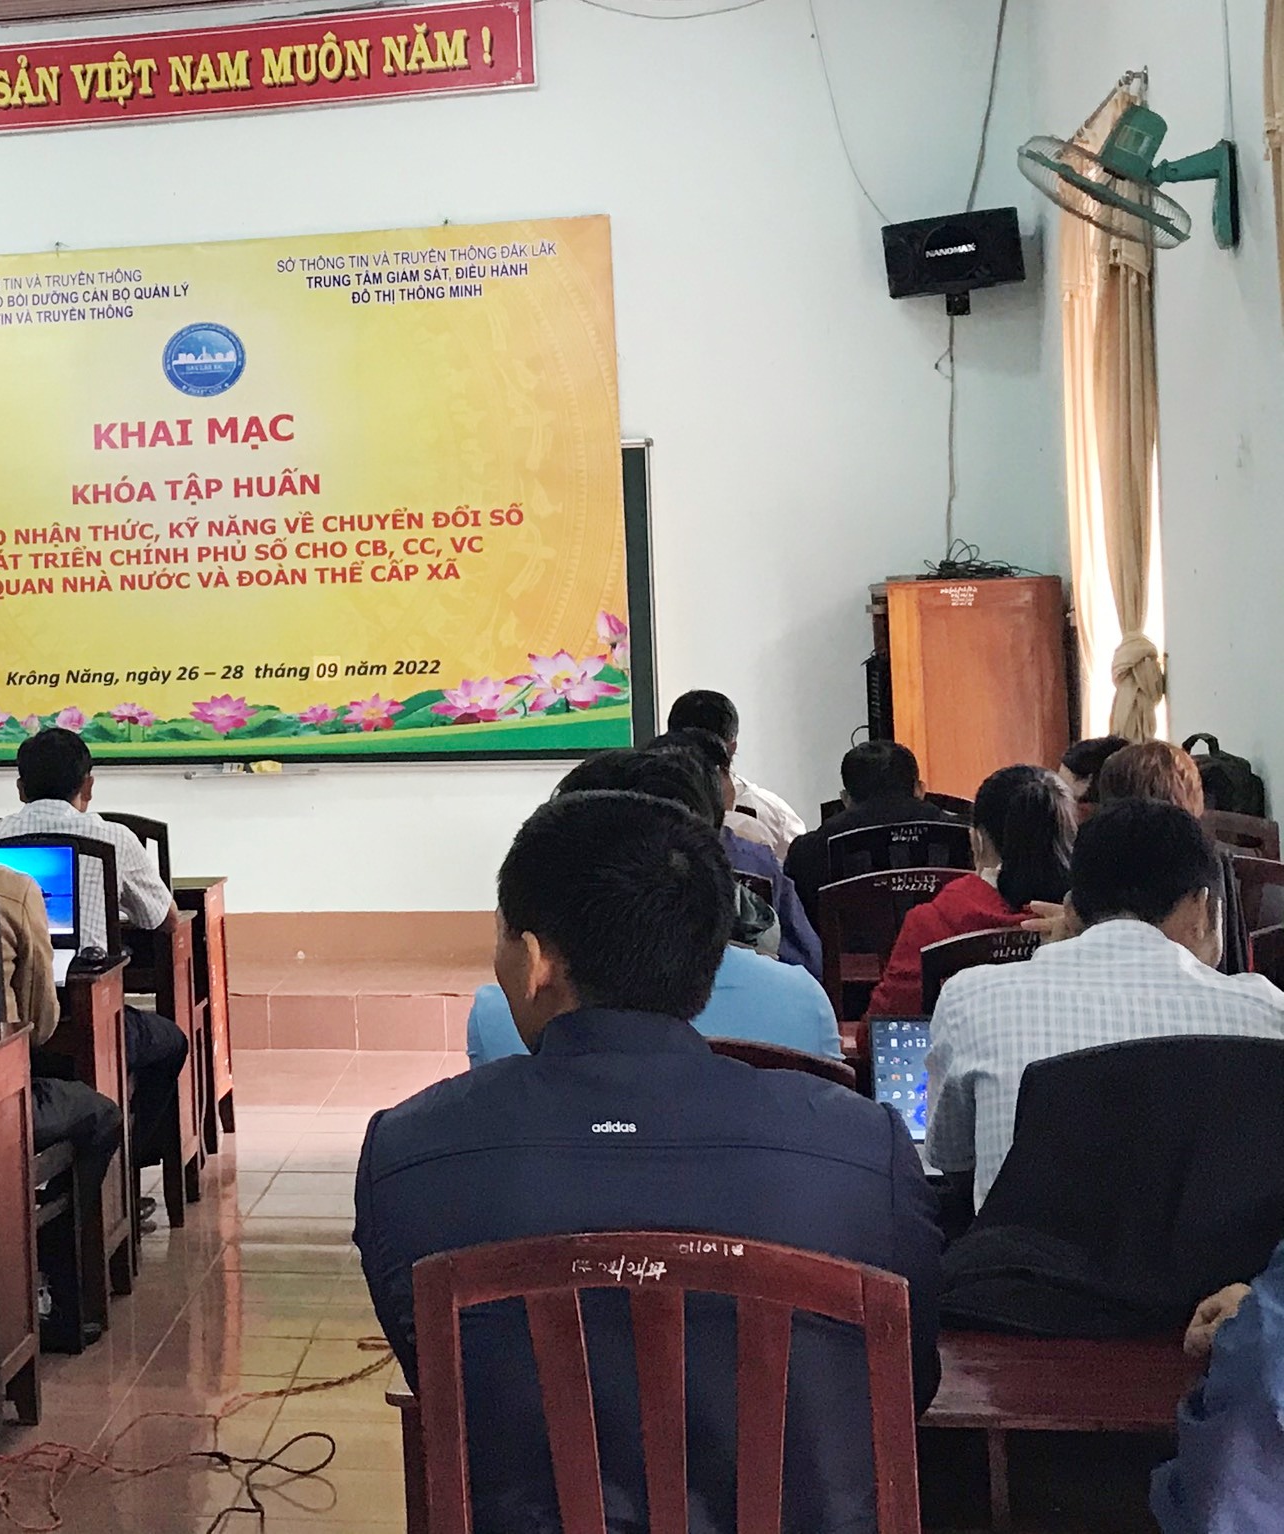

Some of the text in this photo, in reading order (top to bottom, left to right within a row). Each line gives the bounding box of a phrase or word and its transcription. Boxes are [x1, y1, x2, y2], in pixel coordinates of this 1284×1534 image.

[70, 51, 157, 106] VIỆT
[168, 50, 250, 94] NAM
[261, 31, 370, 86] MUÔN
[381, 22, 468, 74] NĂM
[481, 26, 493, 65] !
[299, 255, 345, 271] THÔNG
[348, 255, 369, 268] TIN
[372, 250, 390, 266] VÀ
[450, 245, 496, 261] THÔNG
[926, 242, 976, 258] NANOMAX
[3, 278, 22, 290] TIN
[26, 273, 42, 288] VÀ
[98, 268, 142, 283] THÔNG
[306, 274, 351, 289] TRUNG
[355, 270, 383, 285] TÂM
[386, 267, 420, 284] GIÁM
[490, 262, 528, 277] HÀNH
[112, 287, 130, 303] BỘ
[352, 284, 482, 304] ĐÔ THỊ THÔNG MINH
[16, 309, 33, 324] VÀ
[90, 304, 134, 320] THÔNG
[93, 413, 294, 450] KHAI MẠC
[71, 467, 321, 506] KHÓA TẬP HUẤN
[13, 522, 81, 548] NHẬN
[88, 518, 160, 544] THỨC,
[169, 516, 199, 540] KỸ
[207, 514, 276, 537] NĂNG
[284, 511, 314, 534] VỀ
[322, 506, 424, 532] CHUYỂN
[431, 504, 482, 529] ĐỔI
[490, 503, 524, 527] SỐ
[29, 546, 102, 570] TRIỂN
[110, 544, 189, 566] CHÍNH
[197, 540, 247, 563] PHỦ
[254, 537, 288, 561] SỐ
[295, 542, 347, 560] CHO
[355, 540, 395, 560] CB,
[403, 537, 443, 559] CC,
[450, 536, 484, 554] VC
[62, 570, 113, 593] NHÀ
[119, 568, 191, 592] NƯỚC
[197, 565, 230, 589] VÀ
[236, 564, 307, 588] ĐOÀN
[314, 560, 363, 584] THỂ
[370, 559, 419, 583] CẤP
[426, 558, 461, 581] XÃ
[6, 670, 60, 688] Krông
[65, 668, 120, 686] Năng,
[125, 666, 172, 685] ngày
[176, 665, 200, 681] 26
[221, 665, 244, 679] 28
[255, 663, 310, 681] tháng
[316, 663, 338, 678] 09
[344, 661, 387, 676] năm
[393, 659, 441, 675] 2022
[591, 1120, 637, 1133] adidas
